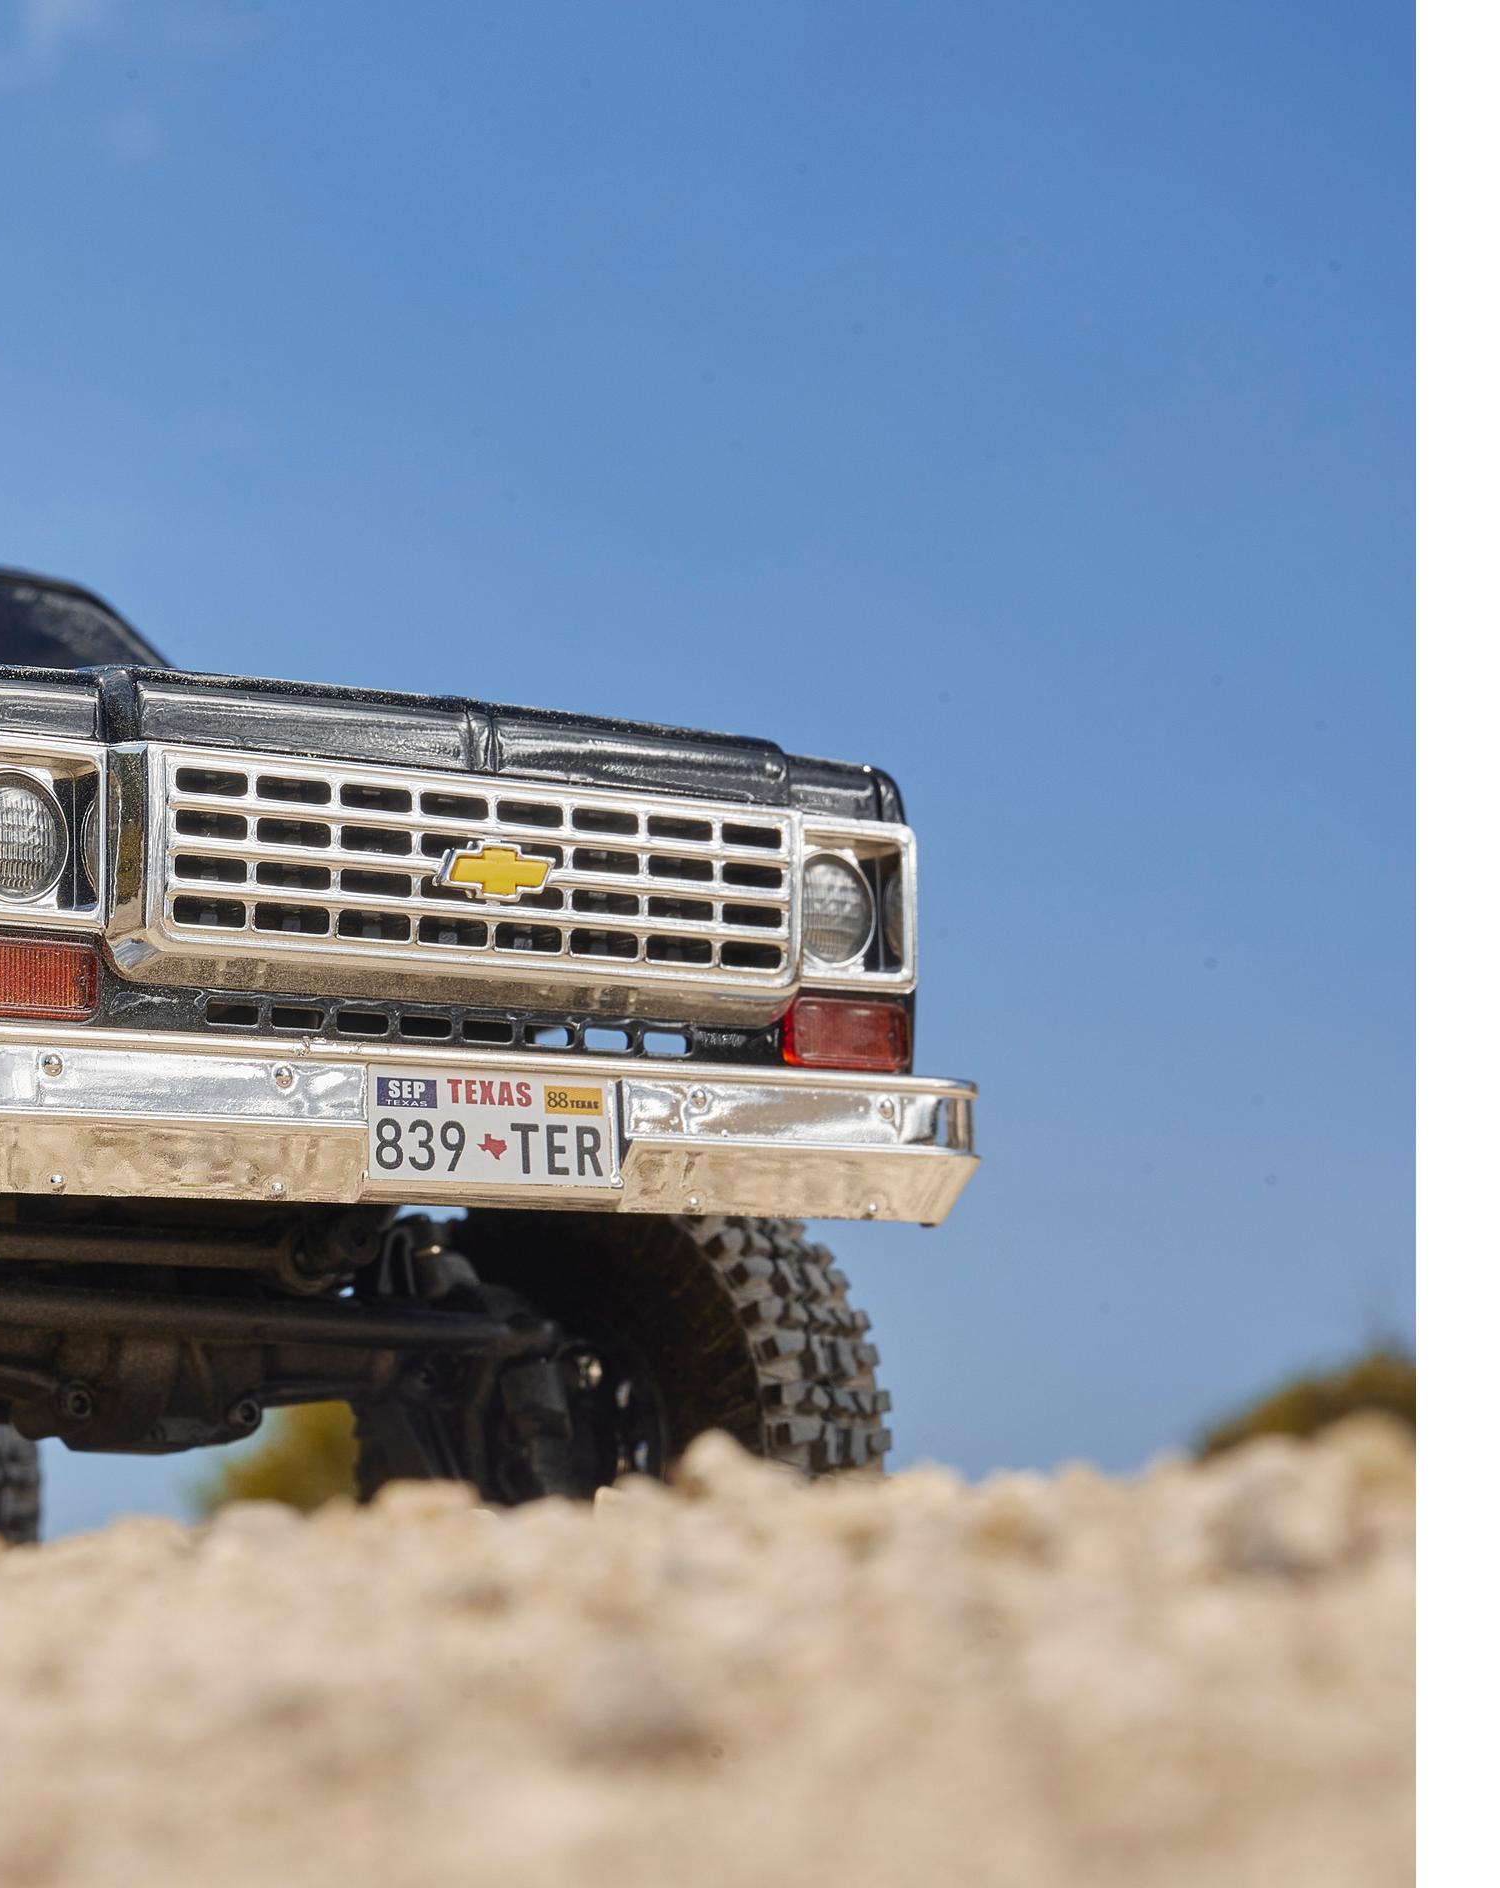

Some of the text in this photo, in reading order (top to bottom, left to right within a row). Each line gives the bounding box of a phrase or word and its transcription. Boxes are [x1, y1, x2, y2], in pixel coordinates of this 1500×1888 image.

[388, 1079, 426, 1099] SEP
[447, 1078, 532, 1108] TEXAS
[385, 1099, 428, 1107] TEXAS
[547, 1091, 599, 1110] 88 TEXAS
[375, 1117, 604, 1177] 839 TER
